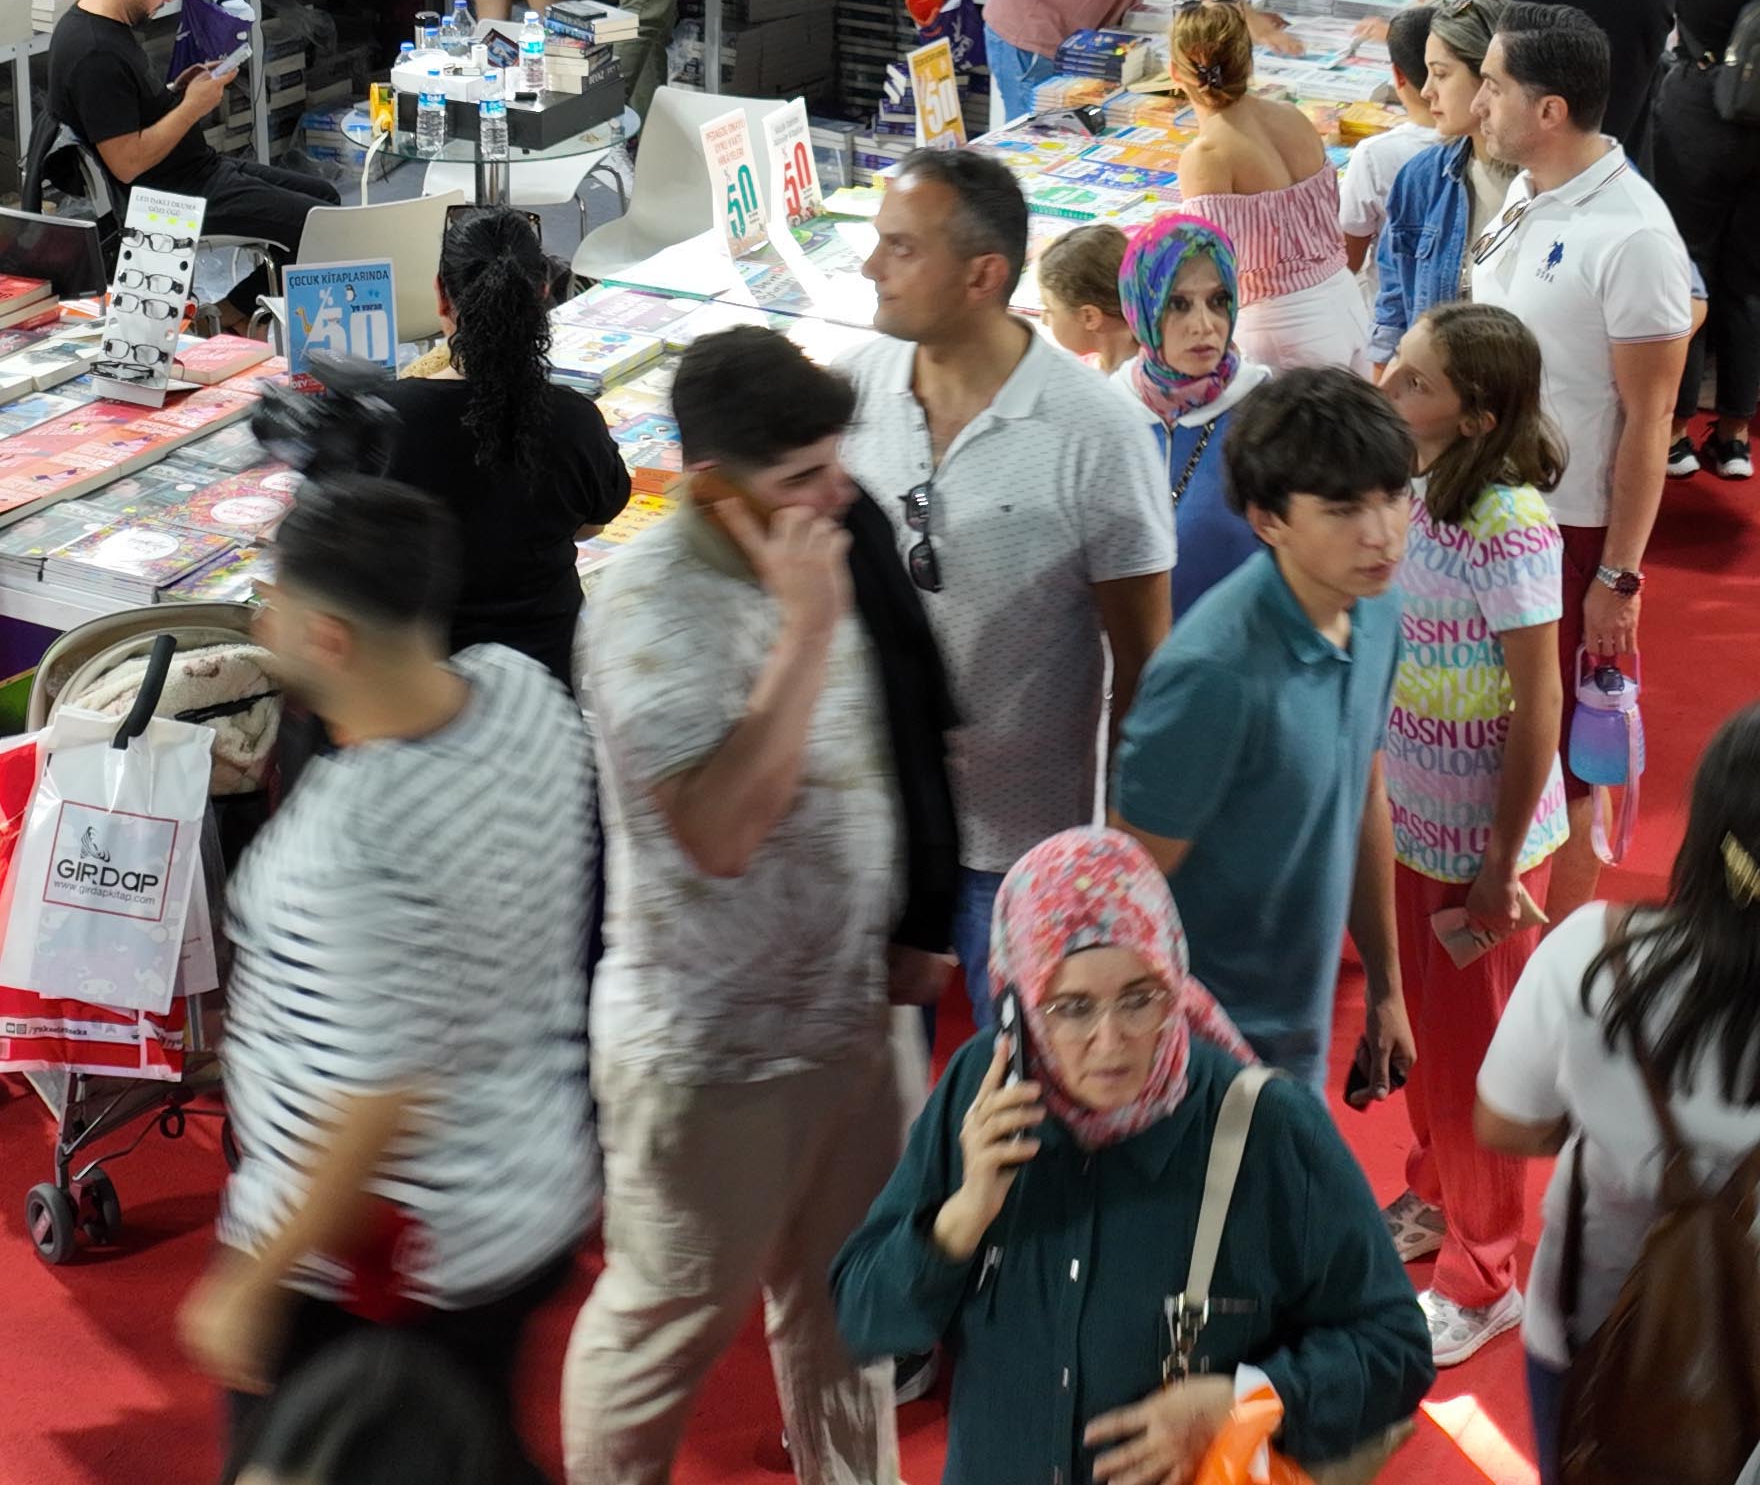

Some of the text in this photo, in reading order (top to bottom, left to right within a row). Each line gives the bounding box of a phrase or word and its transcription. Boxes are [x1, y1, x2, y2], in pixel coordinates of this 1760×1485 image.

[727, 164, 758, 239] 50
[784, 141, 812, 217] 50
[289, 270, 390, 289] ÇOCUK KİTAPLARINDA
[53, 878, 157, 907] www.girdapkitap.com
